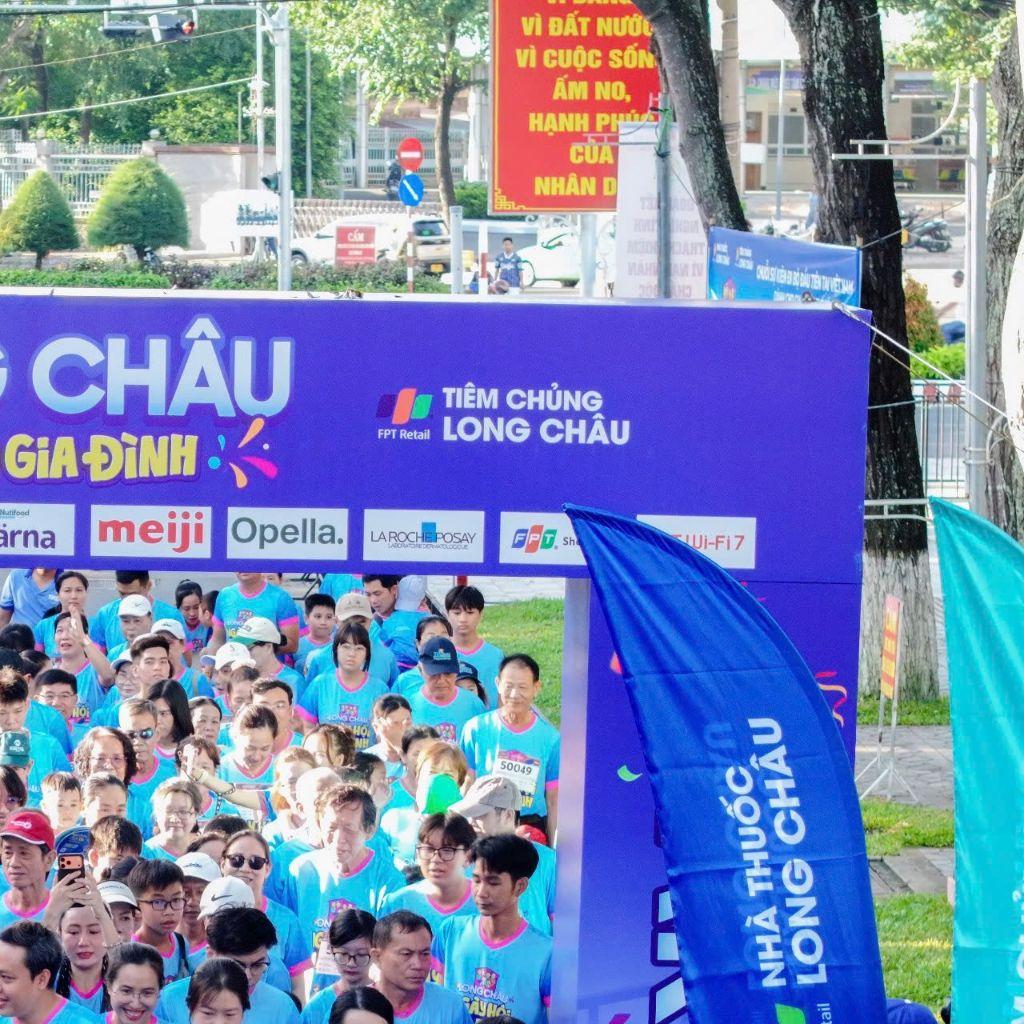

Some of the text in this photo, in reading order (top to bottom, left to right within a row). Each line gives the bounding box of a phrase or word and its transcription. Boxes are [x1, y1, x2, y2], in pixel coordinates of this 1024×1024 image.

[521, 12, 542, 36] VÌ
[548, 10, 591, 37] ĐẤT
[516, 42, 657, 73] VÌ CUỘC SỐN
[552, 74, 631, 103] ẤM NO,
[528, 112, 589, 136] HẠNH
[534, 172, 596, 196] NHÂN
[31, 315, 293, 419] CHÂU
[442, 382, 603, 413] TIÊM CHỦNG
[377, 429, 430, 440] FPT Retail
[443, 413, 630, 445] LONG CHÂU
[0, 508, 30, 517] Nutifood
[98, 510, 204, 554] meiji
[511, 524, 579, 555] FPT Sh
[734, 535, 745, 551] 7
[499, 760, 533, 776] 50049
[747, 716, 828, 985] LONG CHÂU
[718, 764, 787, 989] NHÀ THUỐC
